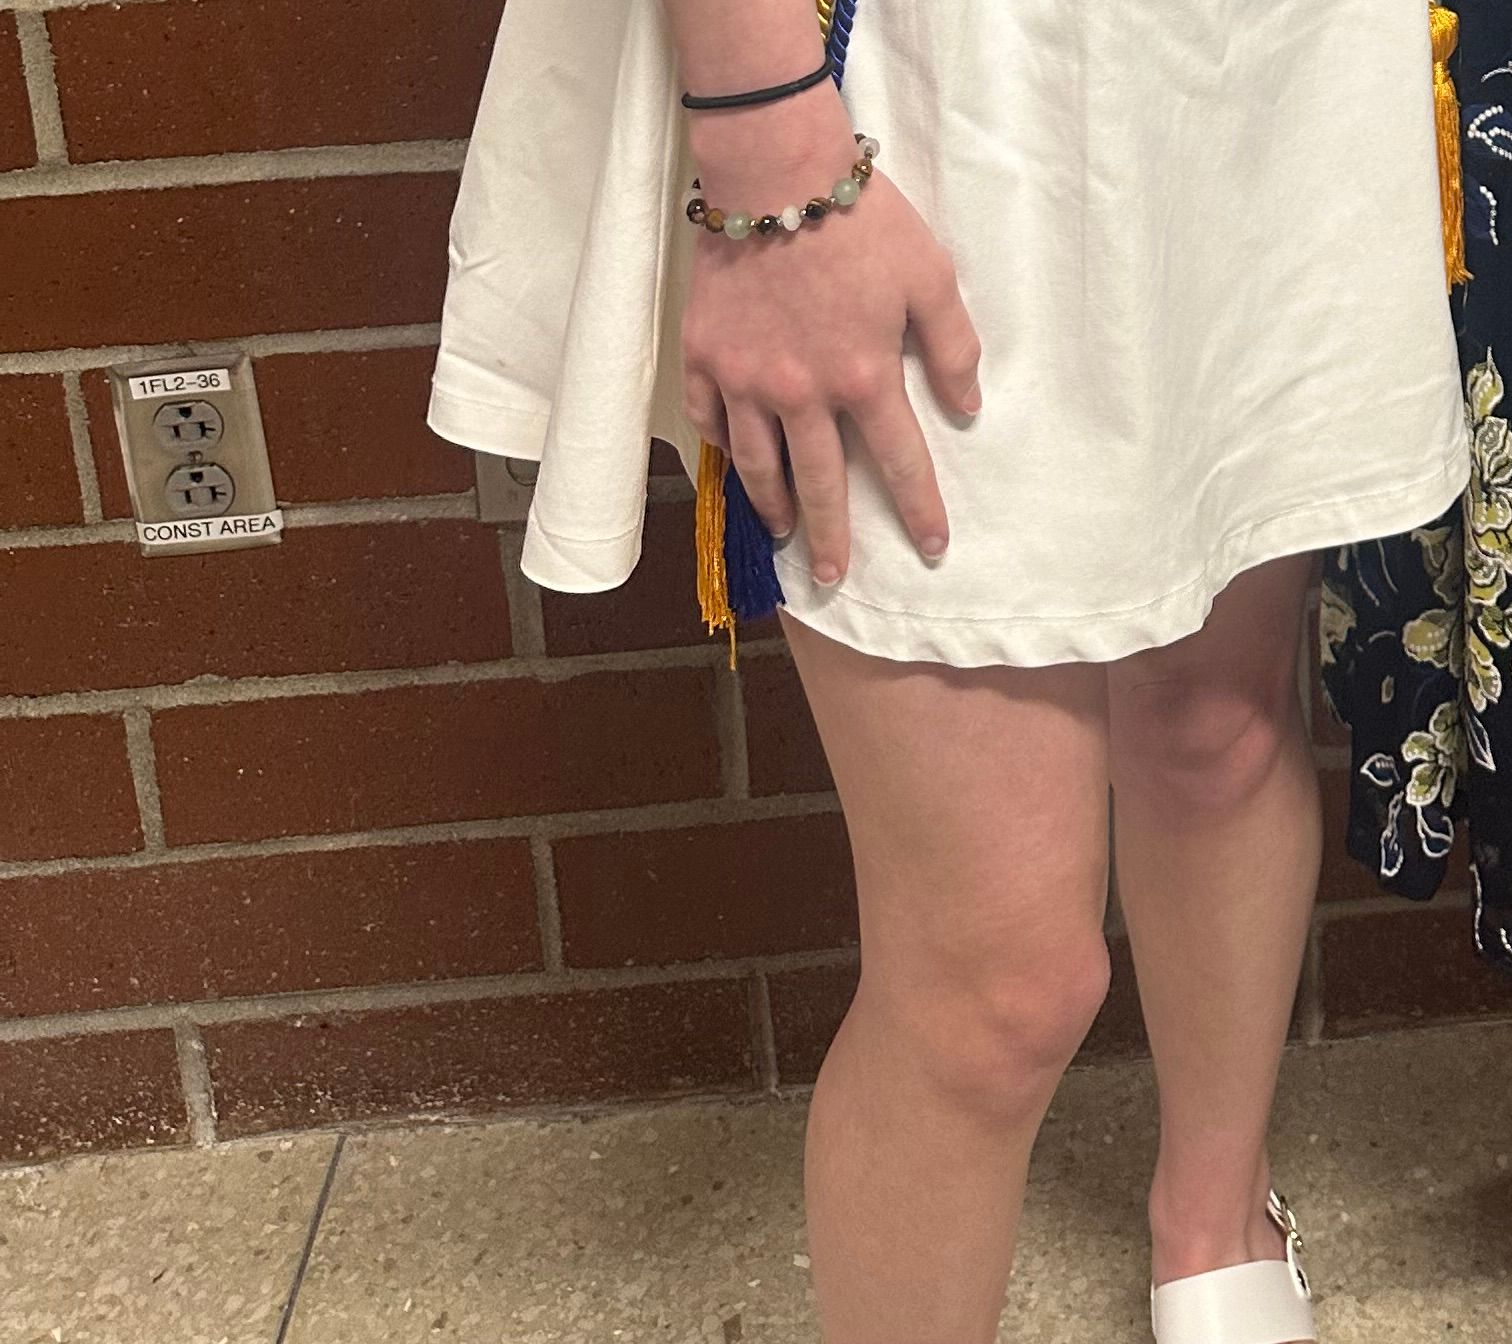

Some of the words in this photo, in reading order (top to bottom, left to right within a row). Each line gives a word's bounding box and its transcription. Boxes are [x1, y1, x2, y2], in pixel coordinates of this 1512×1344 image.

[138, 372, 221, 395] 1FL2-36
[143, 521, 215, 542] CONST
[220, 515, 276, 536] AREA
